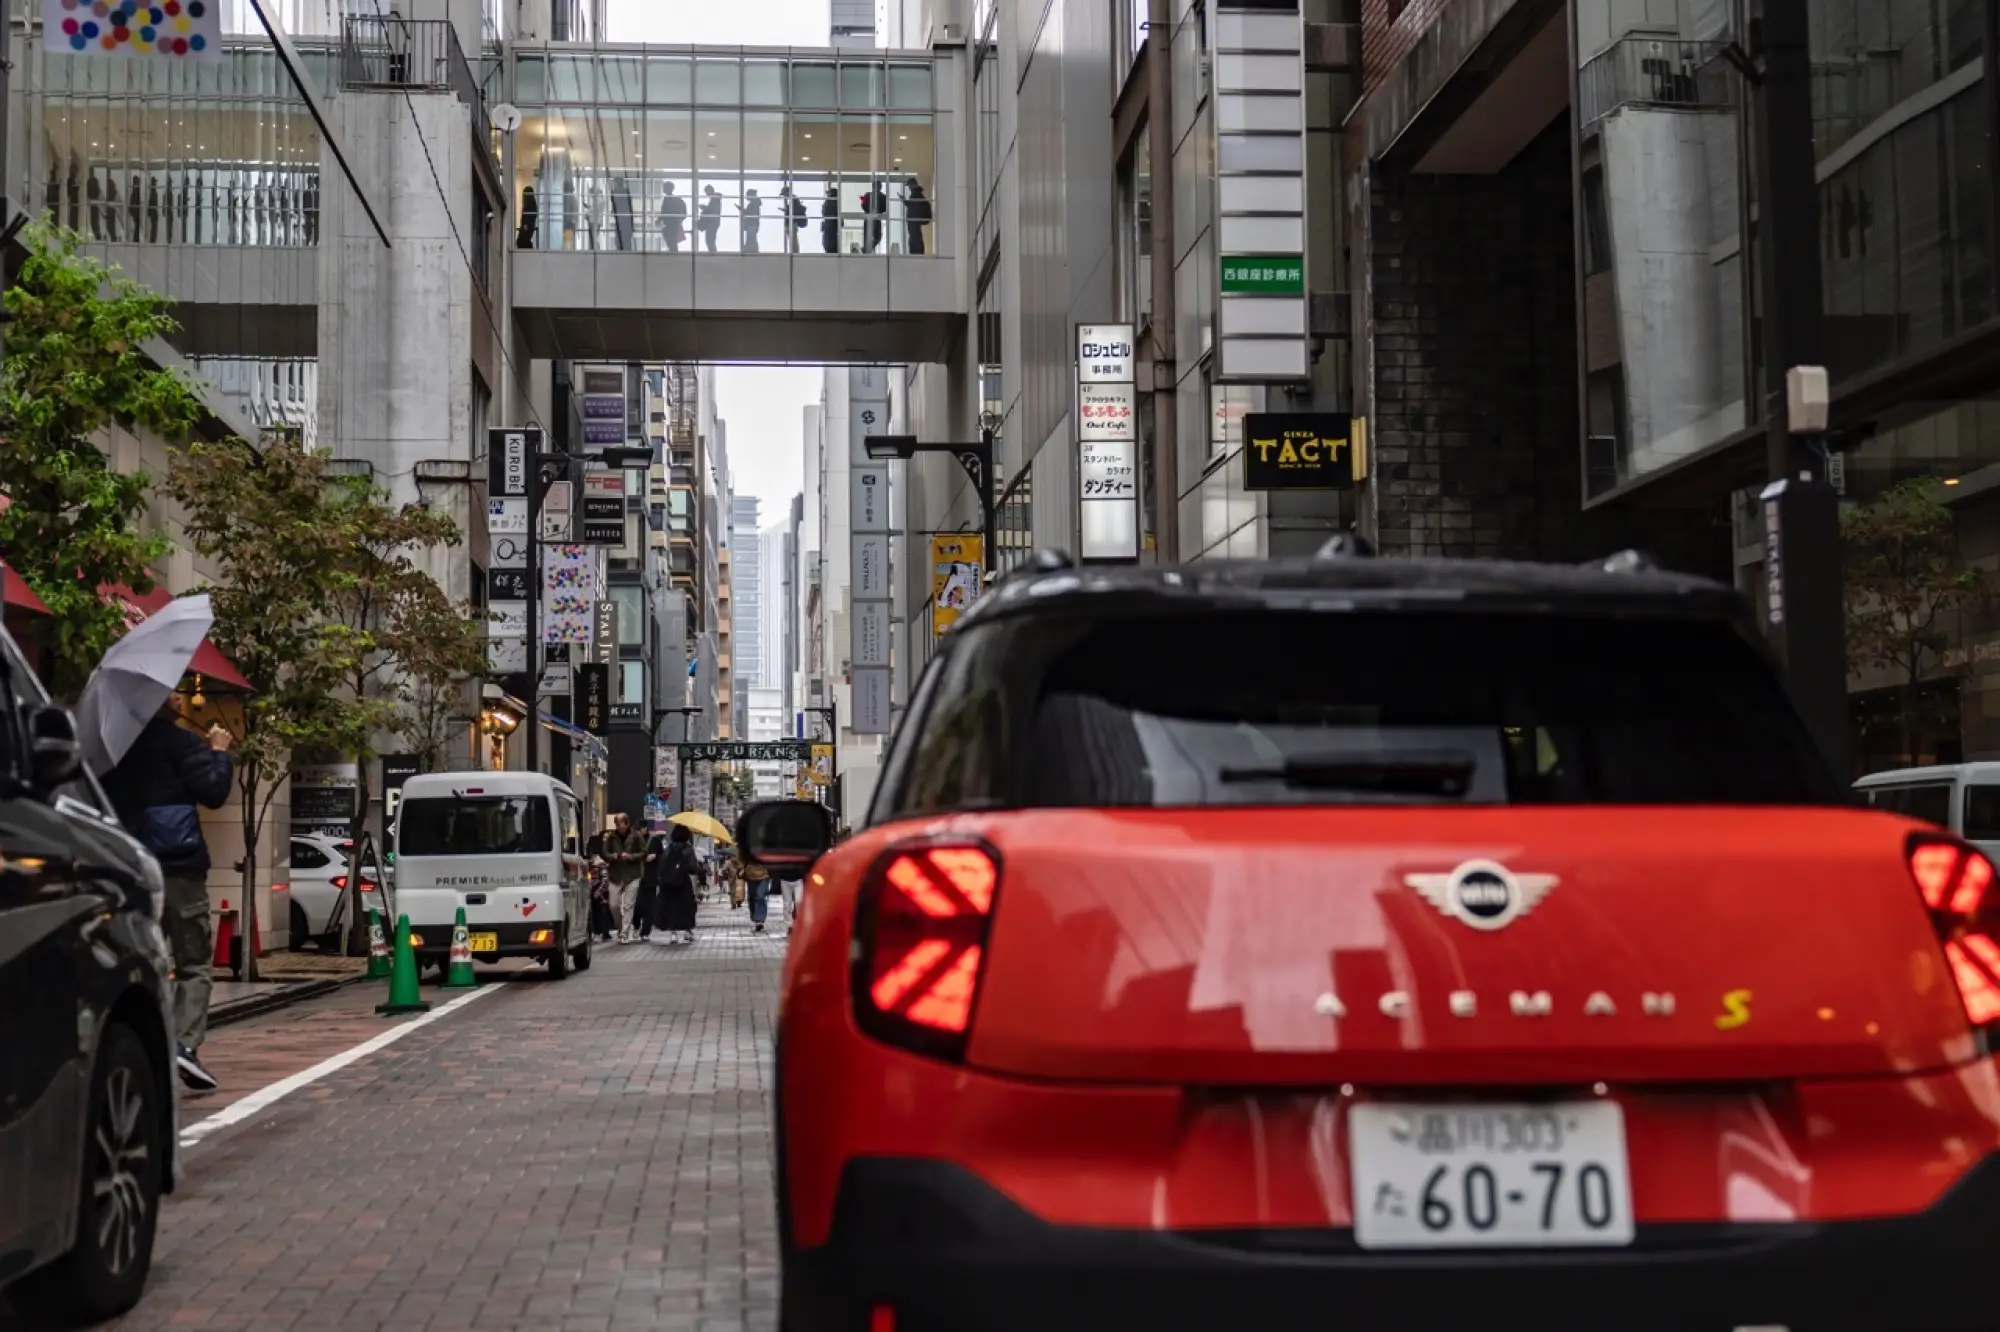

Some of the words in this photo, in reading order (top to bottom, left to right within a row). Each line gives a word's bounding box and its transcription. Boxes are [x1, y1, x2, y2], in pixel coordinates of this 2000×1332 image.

[1224, 268, 1300, 281] 西銀座診療所
[1082, 342, 1130, 358] ロシュビル
[1092, 364, 1122, 375] 事務所
[1082, 405, 1131, 418] もふもふ
[1252, 438, 1347, 462] TACT
[1106, 466, 1132, 475] カラオケ
[1084, 478, 1132, 494] ダンディー
[600, 603, 613, 638] STAR
[693, 745, 785, 760] SUZURAN
[1315, 989, 1676, 1018] ACEMAN
[1713, 988, 1753, 1030] S
[1418, 1161, 1615, 1233] 60-70
